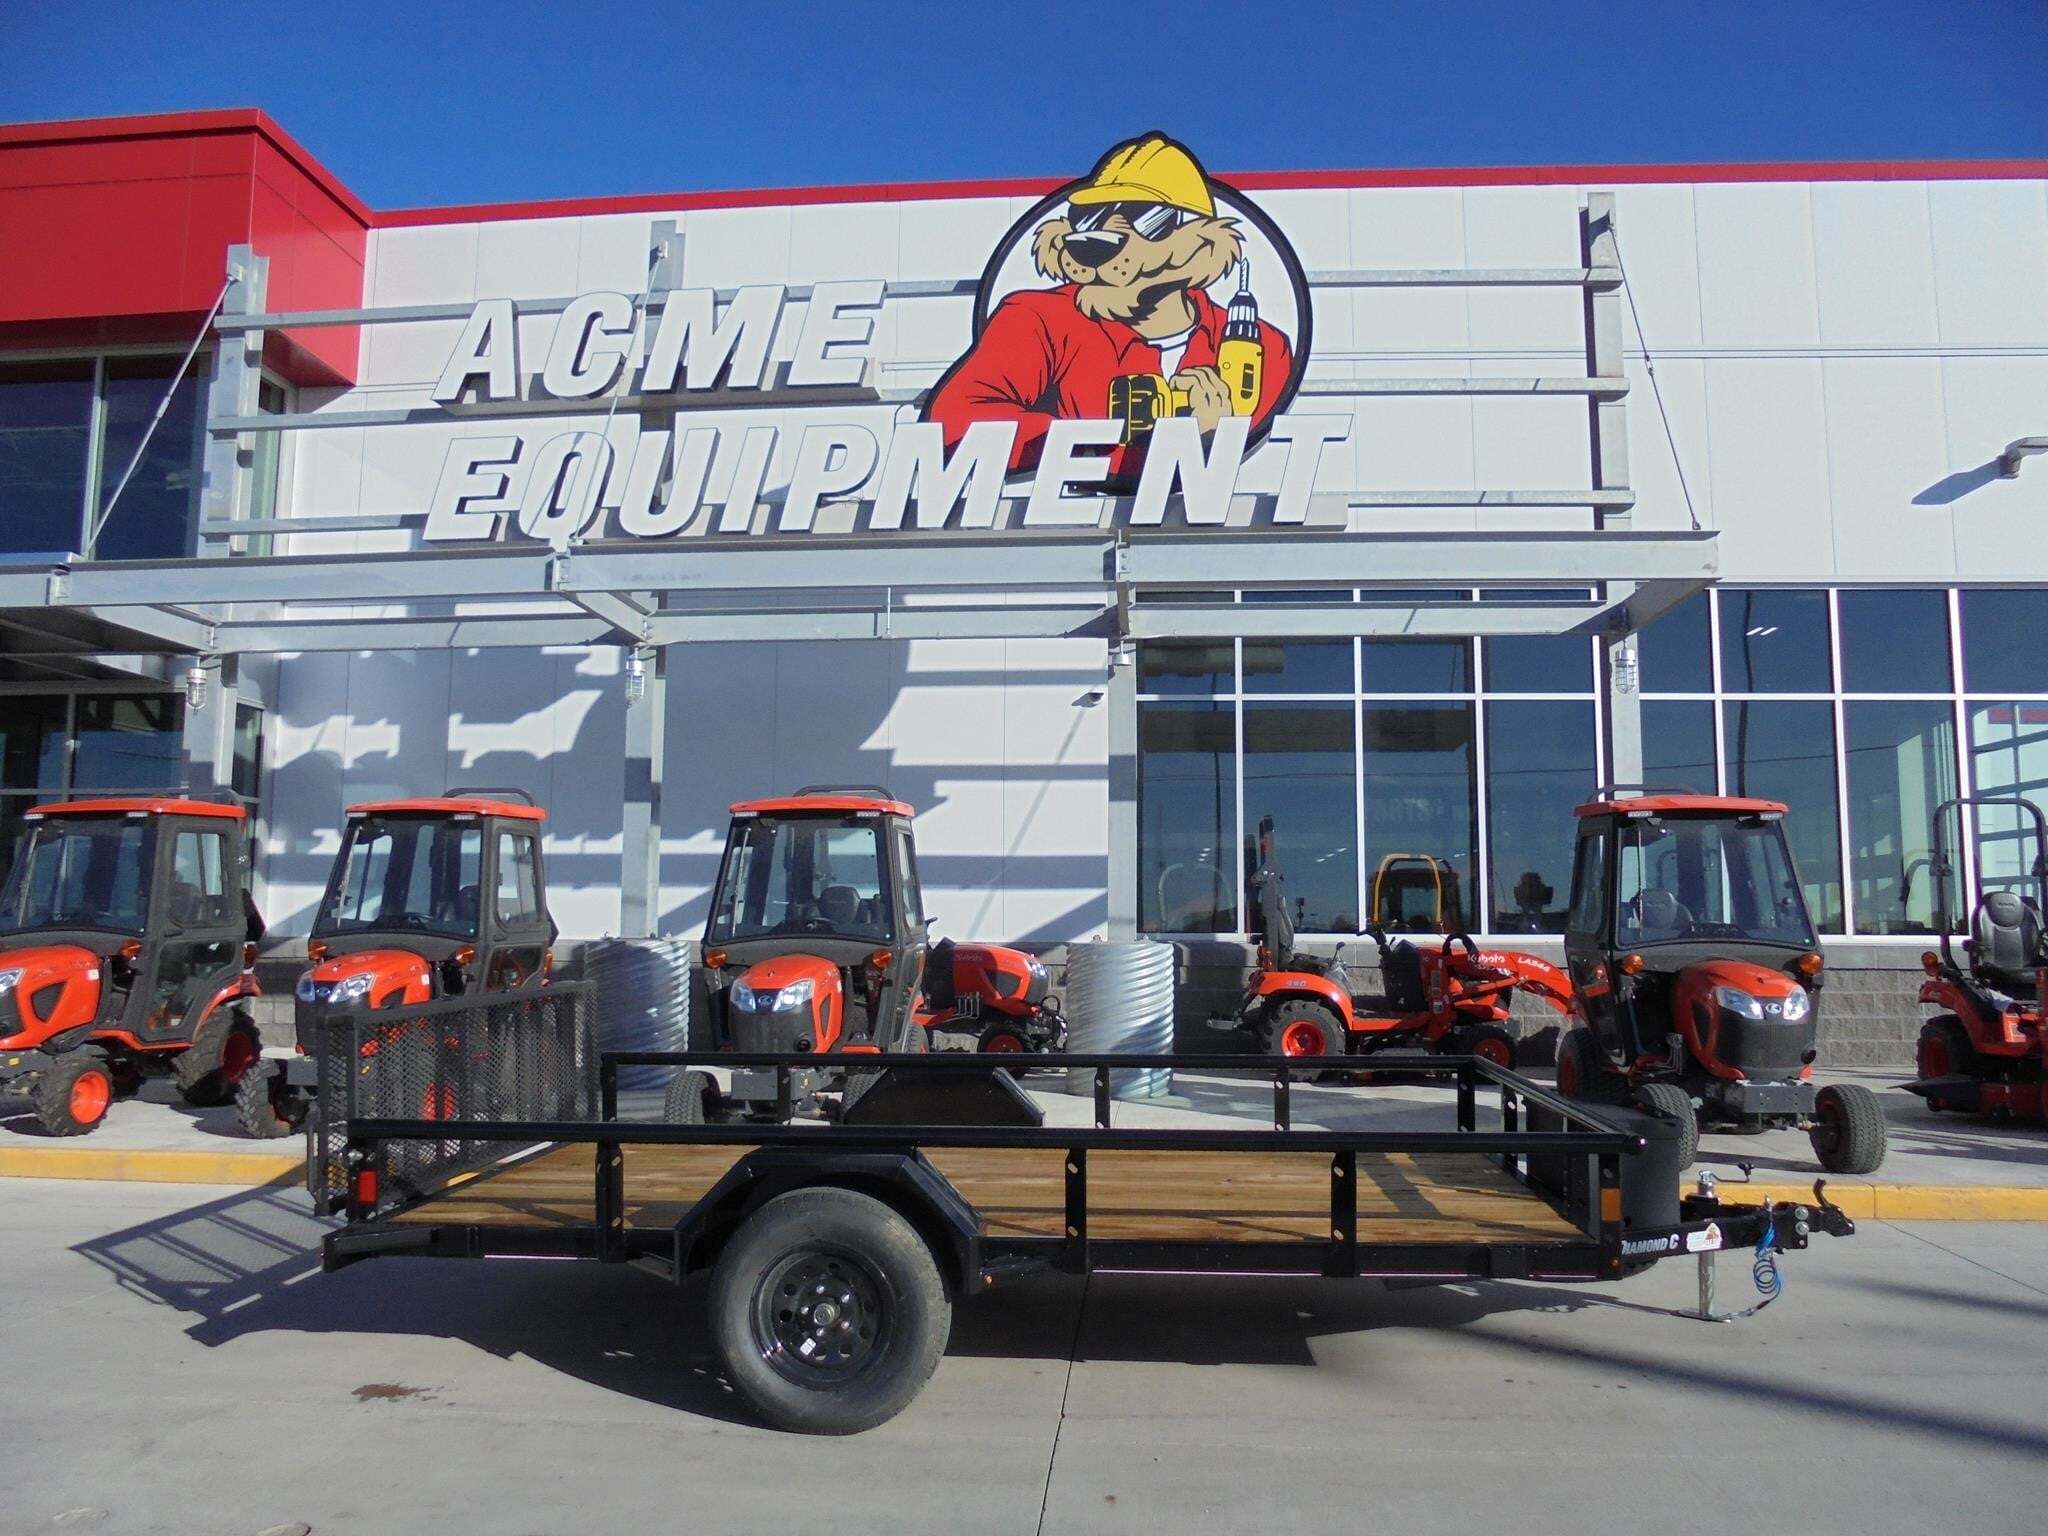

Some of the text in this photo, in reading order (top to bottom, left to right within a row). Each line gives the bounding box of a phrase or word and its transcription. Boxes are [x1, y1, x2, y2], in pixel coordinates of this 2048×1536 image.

[432, 280, 887, 400] ACME
[423, 412, 1354, 552] EQUIPMENT
[1467, 953, 1505, 964] Kubota
[1669, 1233, 1680, 1250] C
